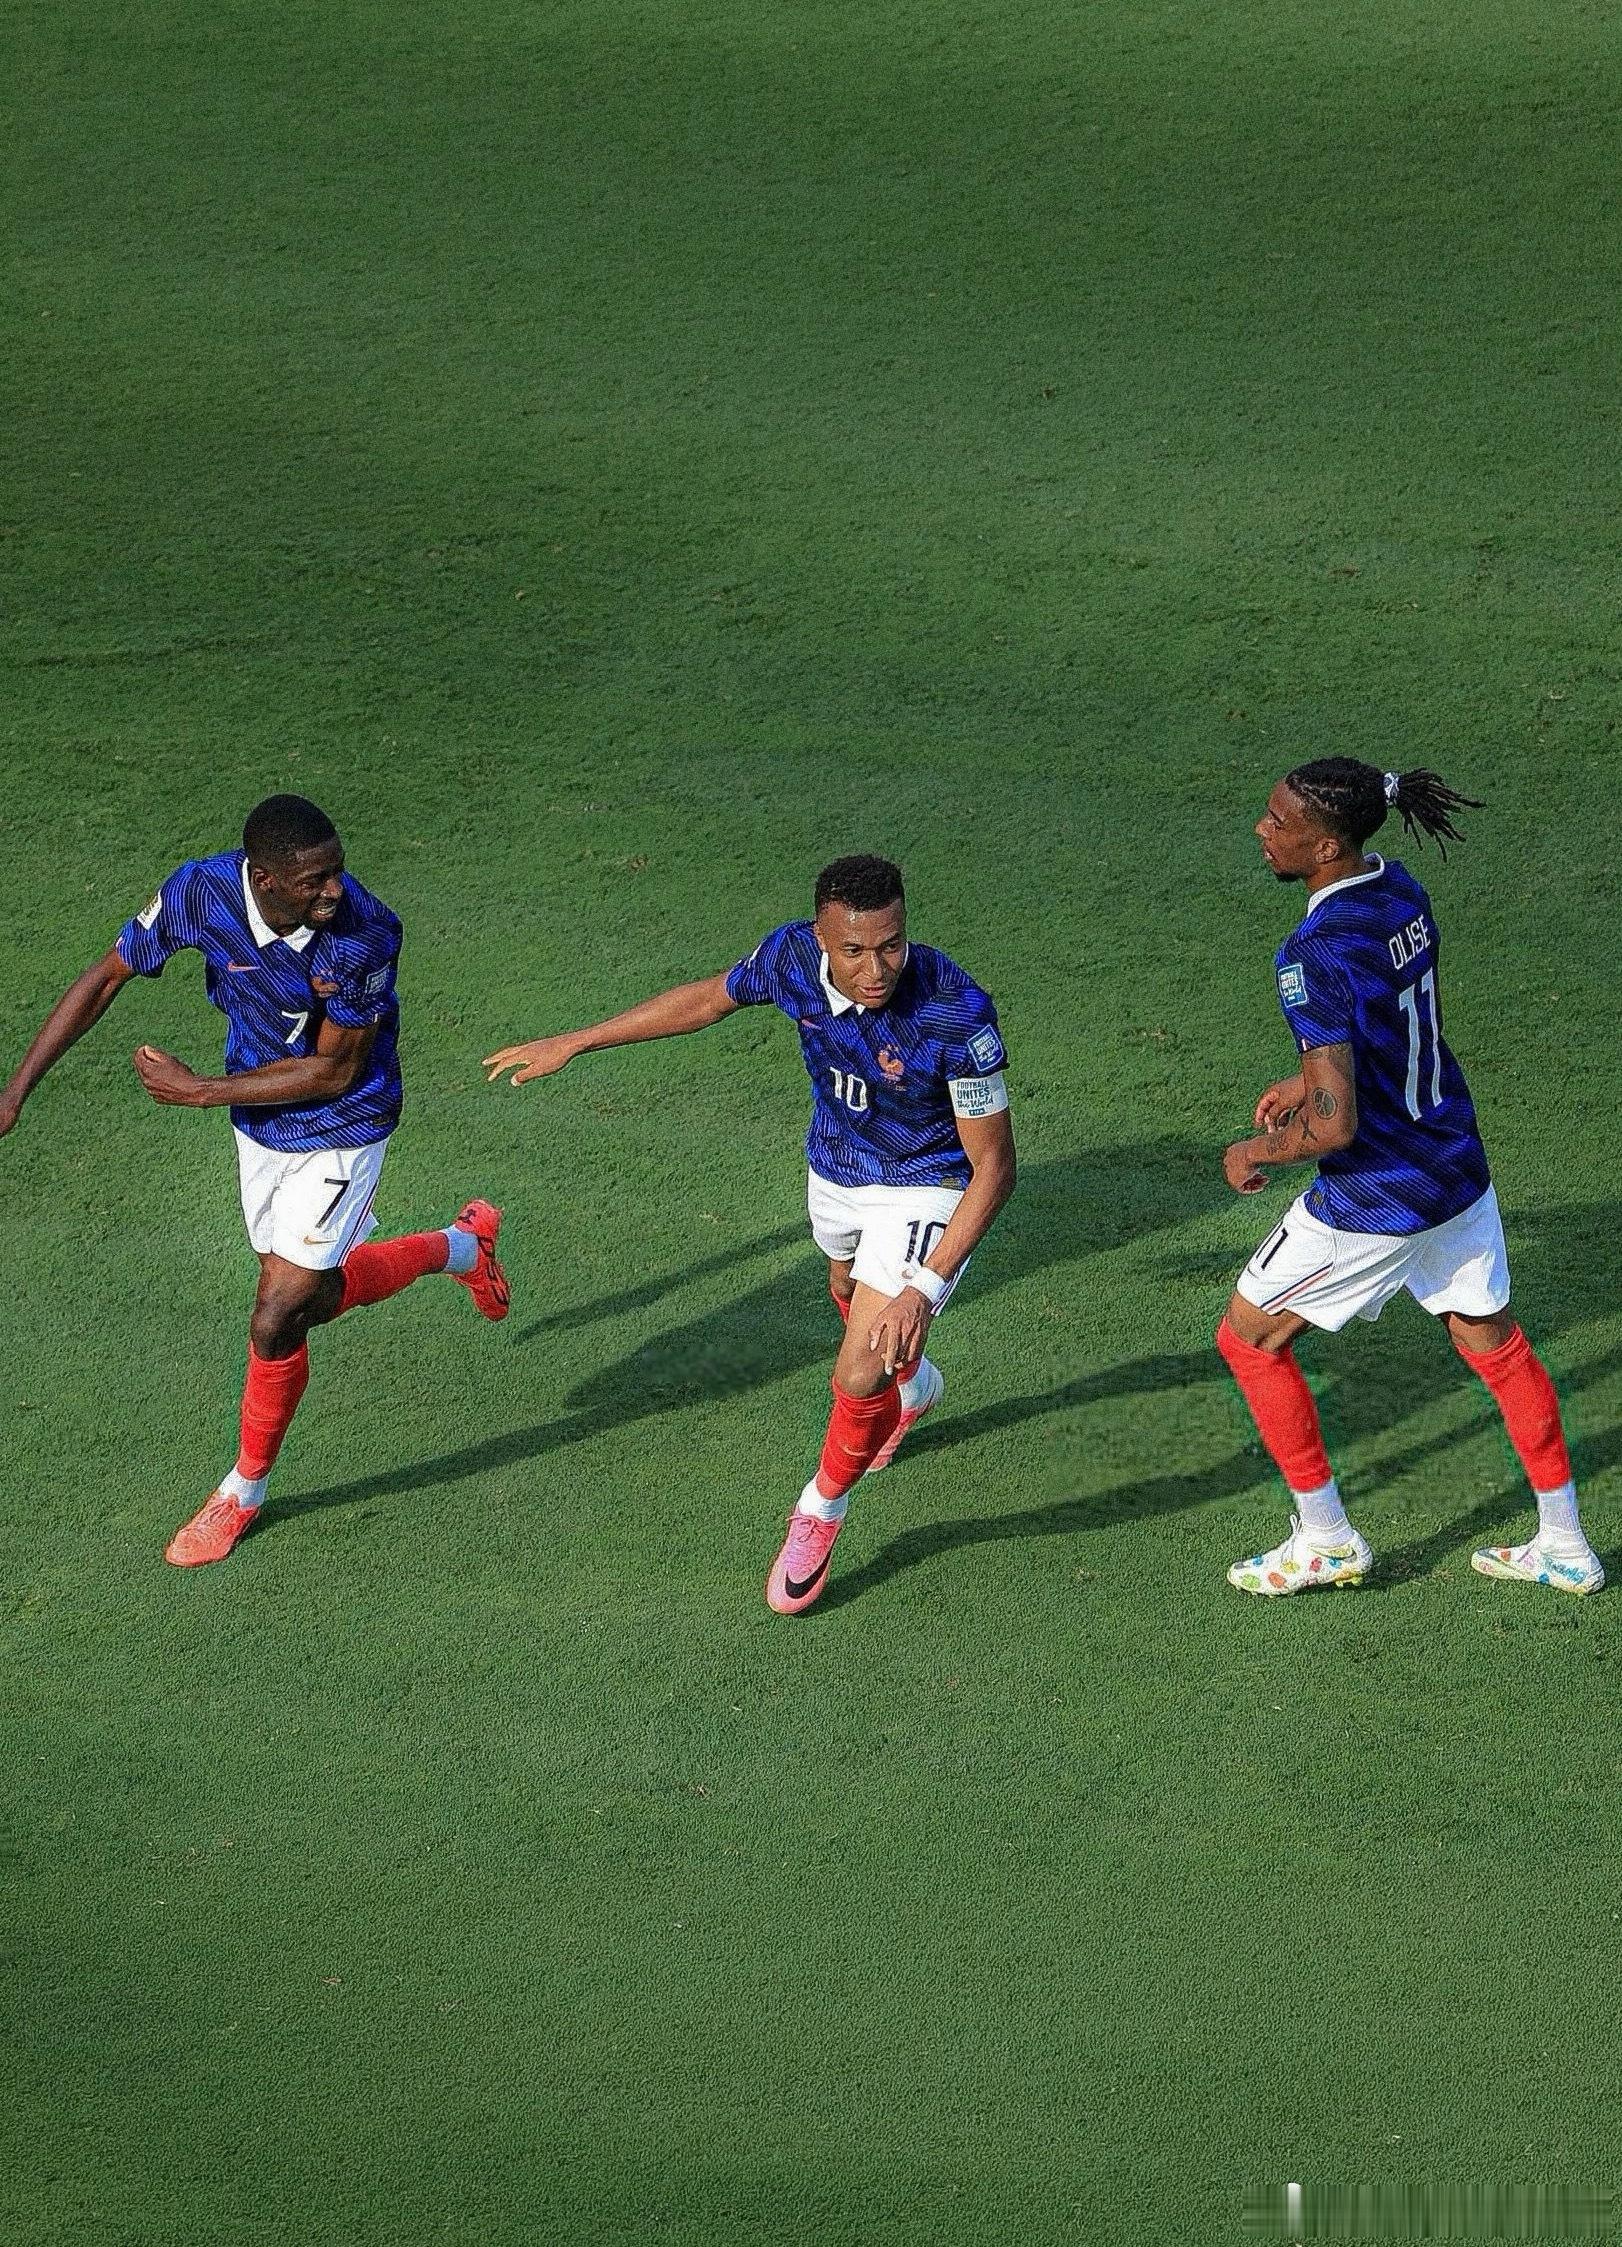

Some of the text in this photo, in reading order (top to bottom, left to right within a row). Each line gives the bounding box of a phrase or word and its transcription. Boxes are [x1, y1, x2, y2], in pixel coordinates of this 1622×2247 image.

[1389, 914, 1431, 970] OLISE
[281, 1010, 308, 1044] 7
[1399, 967, 1442, 1121] 11
[829, 1066, 867, 1112] 10
[957, 1080, 990, 1090] FOOTBALL
[957, 1086, 991, 1099] UNITES
[970, 1095, 994, 1108] World
[315, 1178, 351, 1229] 7
[904, 1220, 948, 1267] 10
